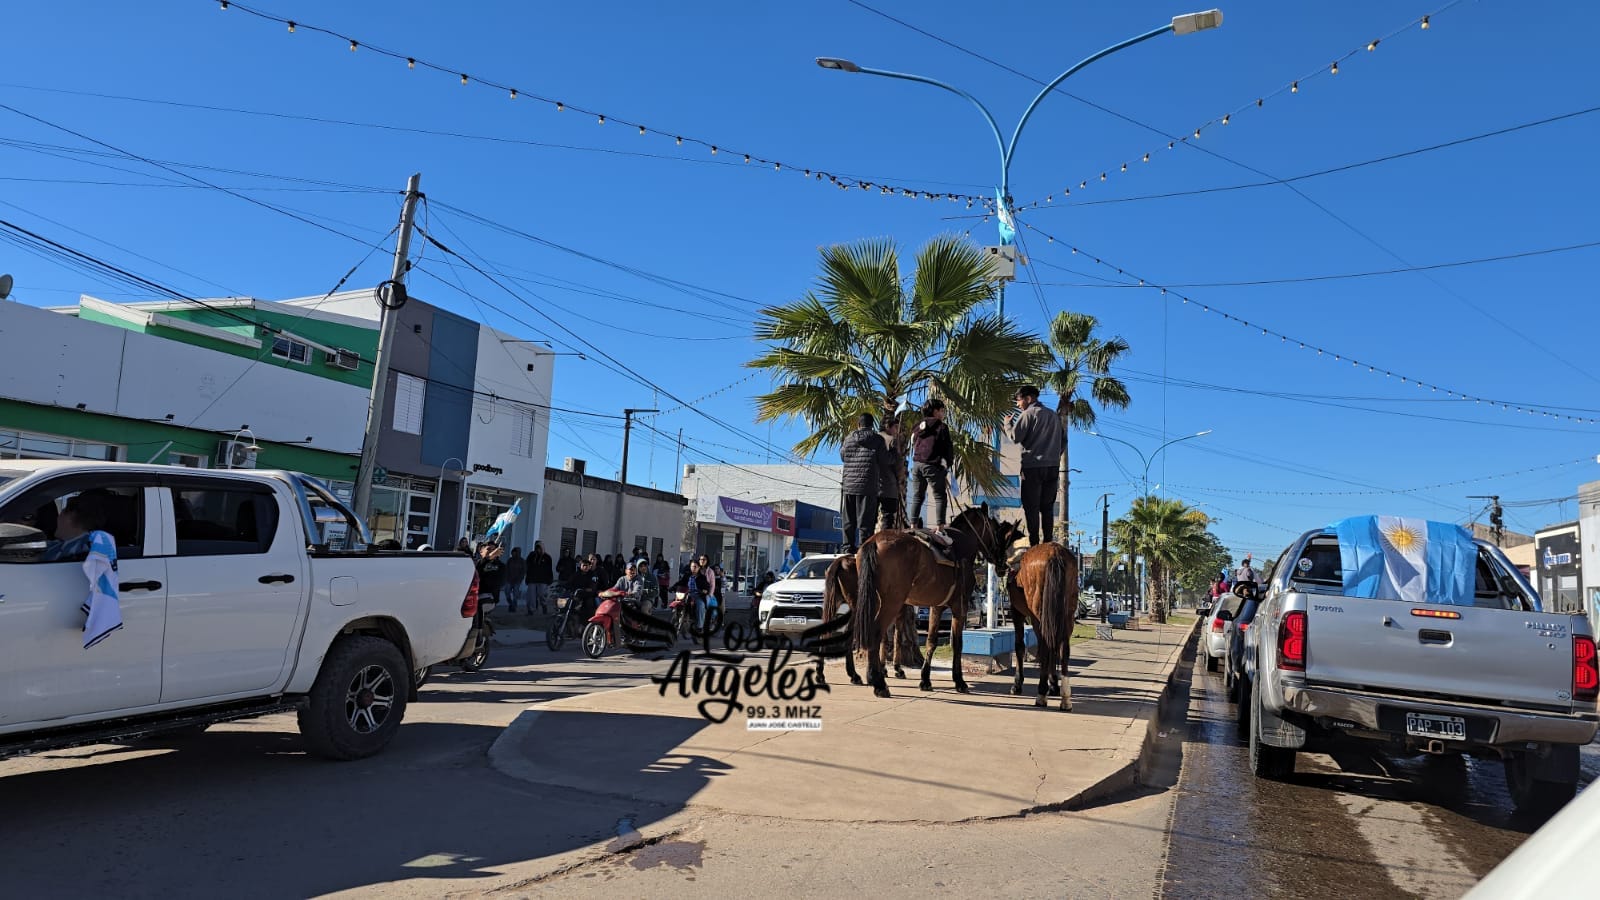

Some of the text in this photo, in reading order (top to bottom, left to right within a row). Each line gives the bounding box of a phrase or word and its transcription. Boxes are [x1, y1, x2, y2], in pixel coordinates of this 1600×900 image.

[473, 464, 503, 475] goodboys
[1313, 604, 1344, 613] TOYOTA
[1409, 718, 1463, 736] PAP 103
